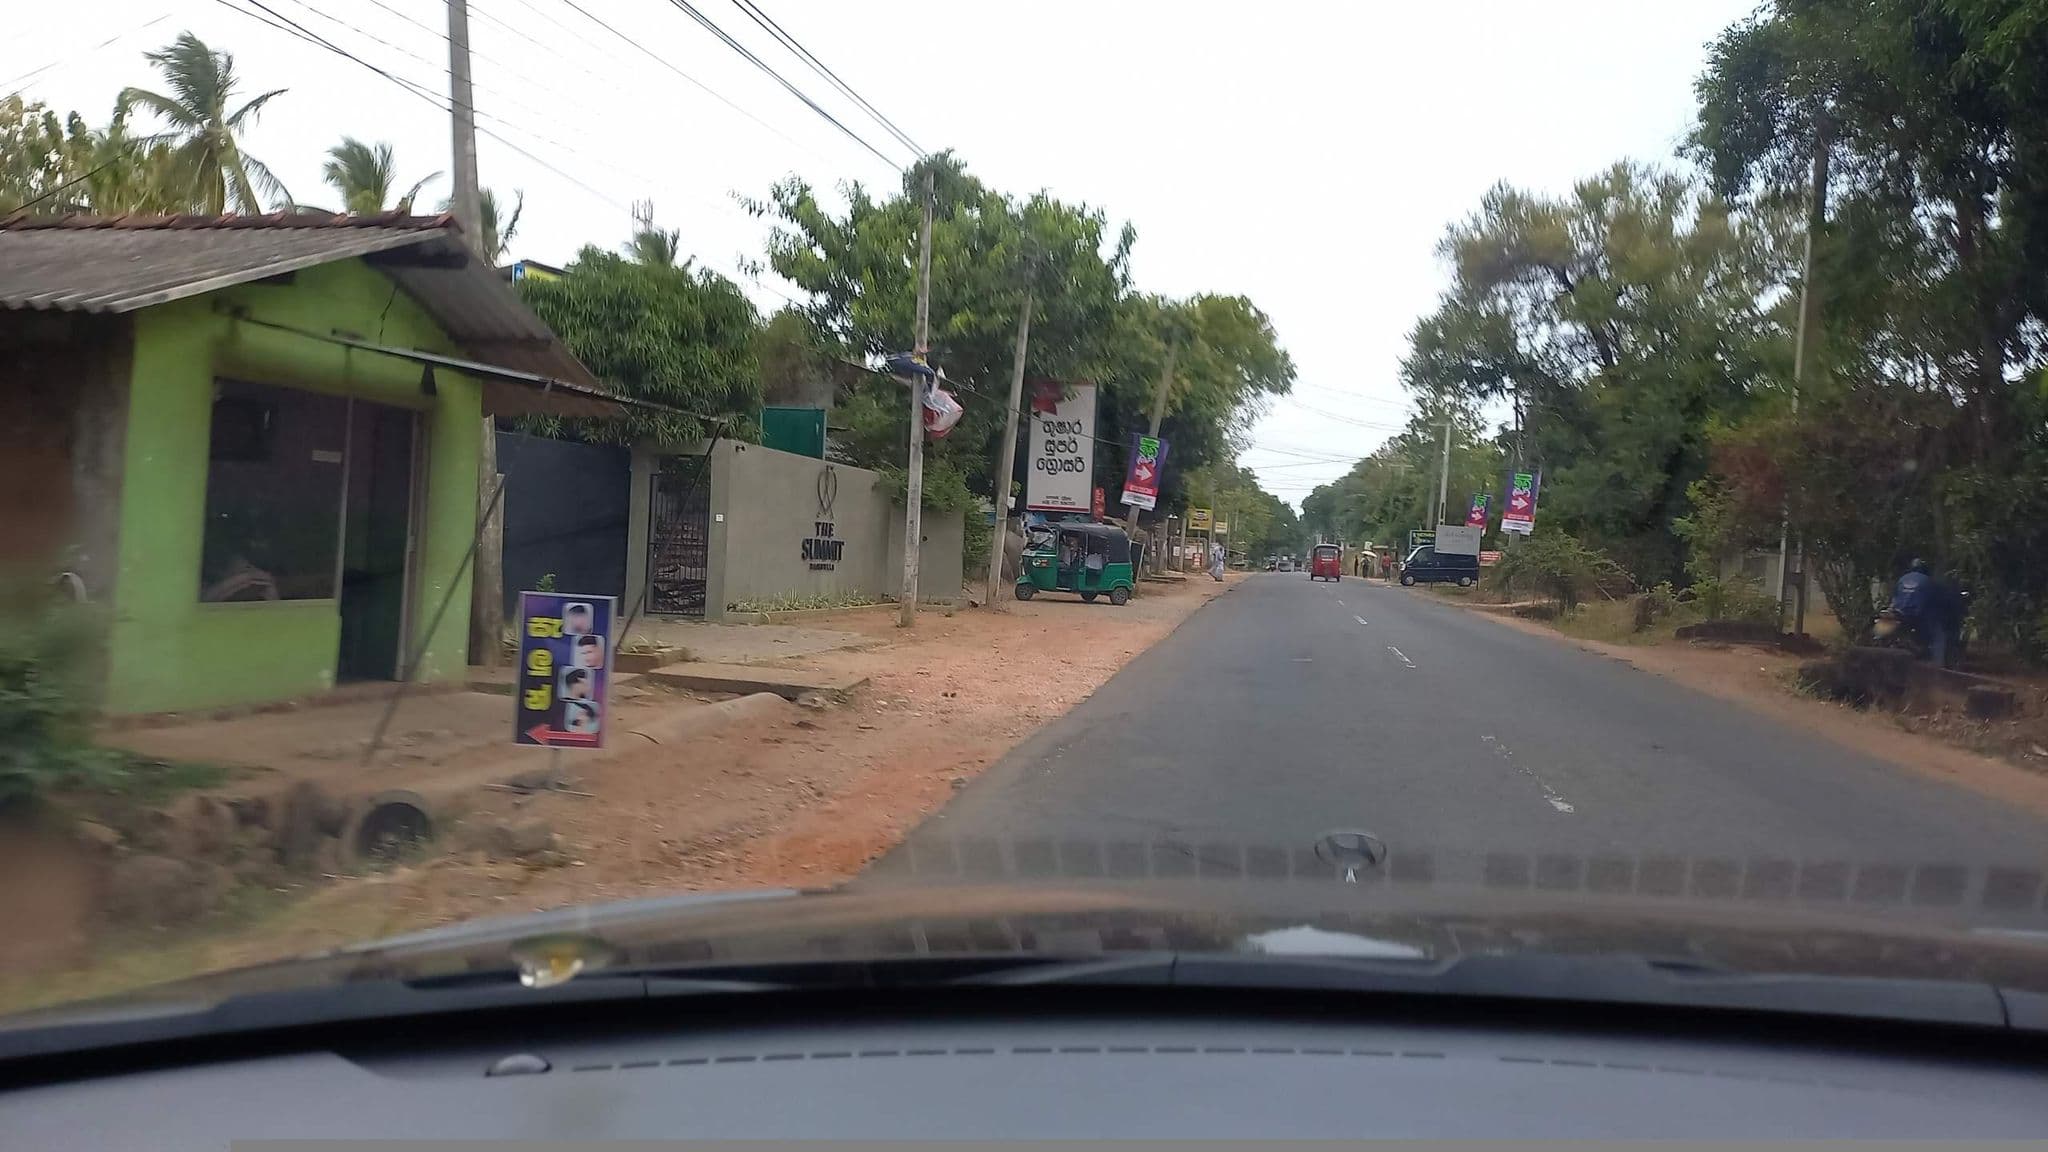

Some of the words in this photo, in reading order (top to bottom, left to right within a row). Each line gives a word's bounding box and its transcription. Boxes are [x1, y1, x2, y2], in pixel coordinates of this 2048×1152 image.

[1045, 437, 1077, 456] සුපර්
[815, 522, 834, 537] THE
[802, 539, 844, 561] SUMMIT
